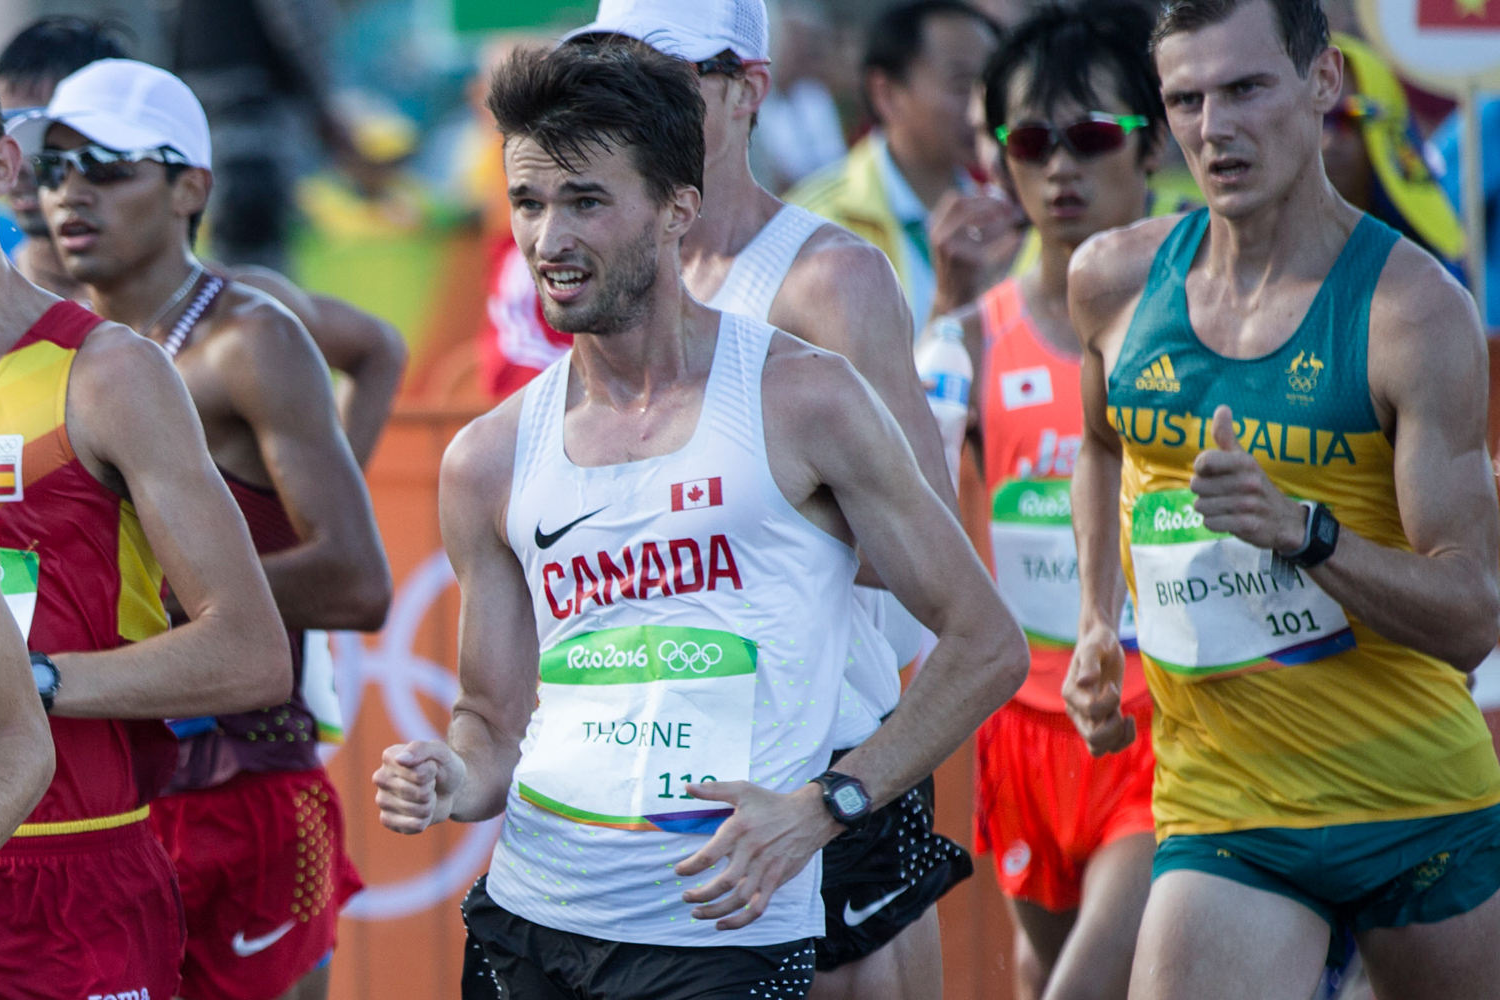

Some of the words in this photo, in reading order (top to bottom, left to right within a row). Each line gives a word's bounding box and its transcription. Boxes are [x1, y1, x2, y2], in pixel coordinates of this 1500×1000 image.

[1135, 376, 1181, 393] adidas
[1153, 506, 1204, 532] Rio20
[542, 534, 743, 620] CANADA
[1022, 556, 1078, 582] TAKA
[1266, 609, 1321, 637] 101
[567, 644, 649, 670] Rio2016
[582, 721, 693, 749] THORNE
[657, 772, 719, 800] 11
